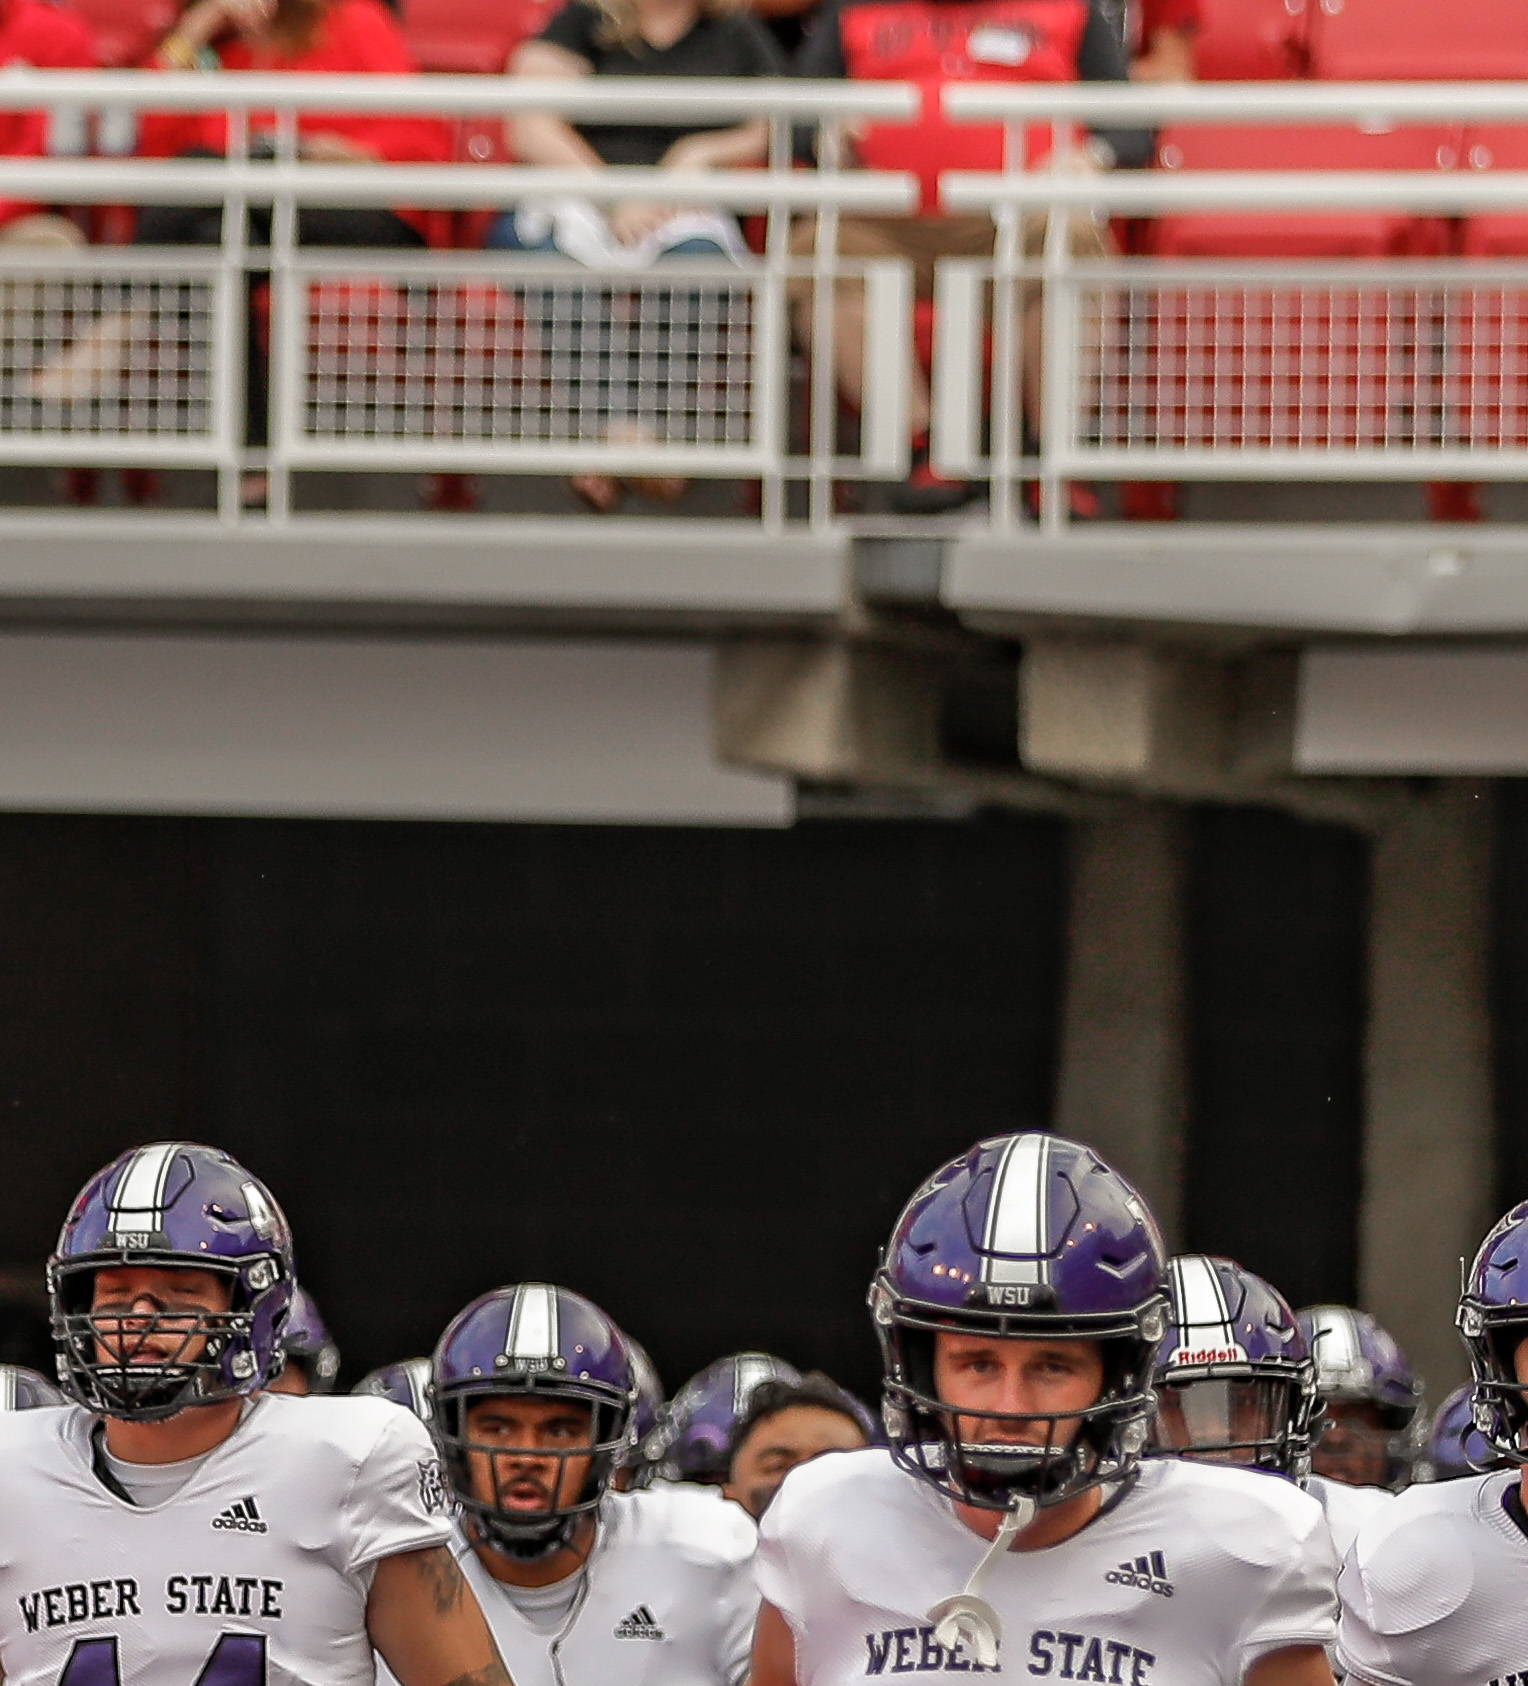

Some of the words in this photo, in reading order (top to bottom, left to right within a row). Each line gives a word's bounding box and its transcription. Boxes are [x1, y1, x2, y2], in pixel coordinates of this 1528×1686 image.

[115, 1233, 150, 1249] WSU
[987, 1285, 1032, 1305] WSU
[1178, 1348, 1238, 1364] Riddell
[212, 1517, 268, 1534] adidas
[1105, 1569, 1175, 1598] adidas
[19, 1577, 140, 1633] WEBER
[166, 1576, 284, 1618] STATE
